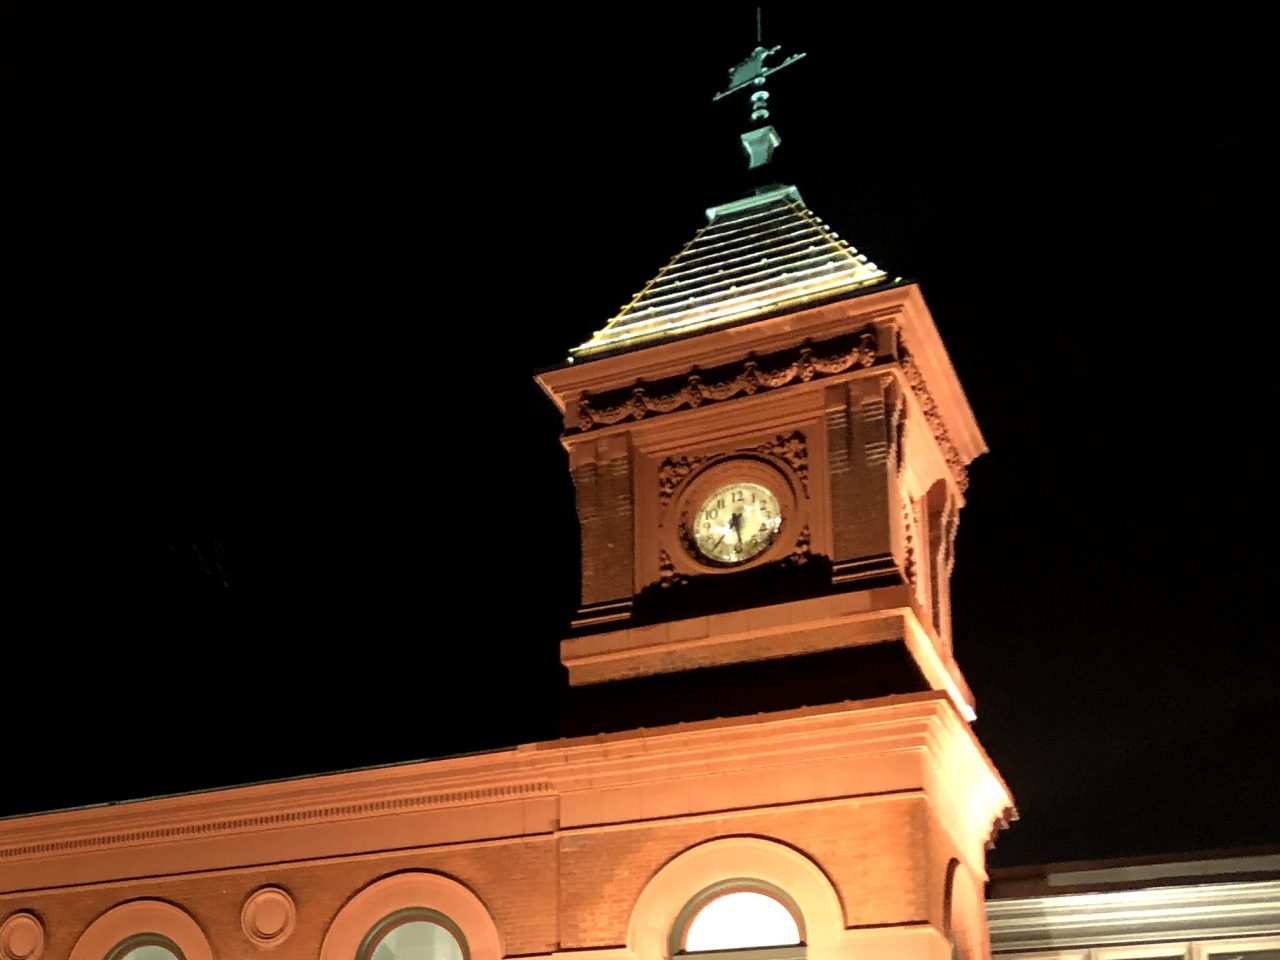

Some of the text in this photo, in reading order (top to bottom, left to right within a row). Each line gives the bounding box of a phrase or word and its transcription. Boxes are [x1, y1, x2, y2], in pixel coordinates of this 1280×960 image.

[732, 490, 744, 503] 12
[717, 498, 725, 509] 11
[705, 508, 718, 520] 10
